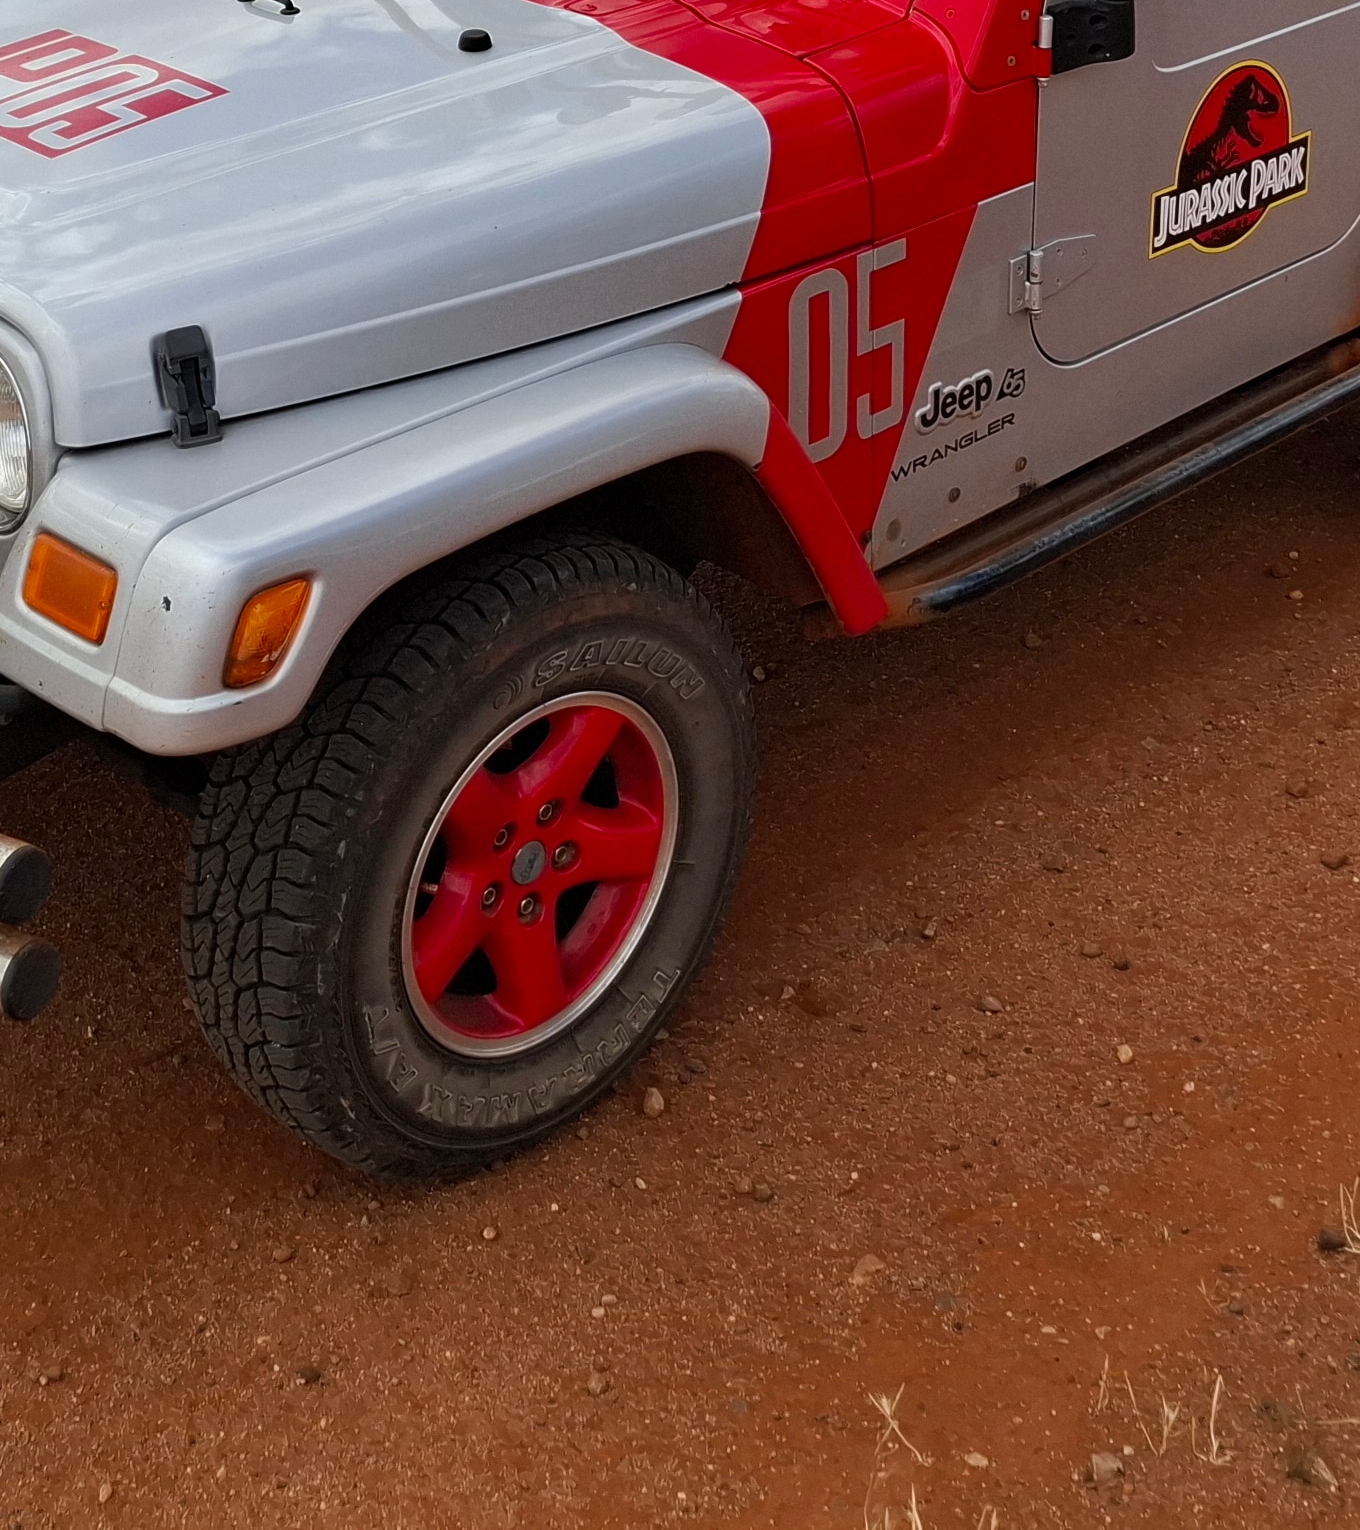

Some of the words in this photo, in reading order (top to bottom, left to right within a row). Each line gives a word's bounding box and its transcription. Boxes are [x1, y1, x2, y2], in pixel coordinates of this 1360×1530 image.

[1153, 168, 1248, 248] JURASSIC
[1248, 146, 1306, 210] PARK
[788, 237, 907, 464] 05
[916, 371, 993, 430] Jeep
[890, 412, 1016, 483] WRANGLER
[535, 638, 706, 700] SAILUN
[416, 969, 681, 1128] TERRAMAX
